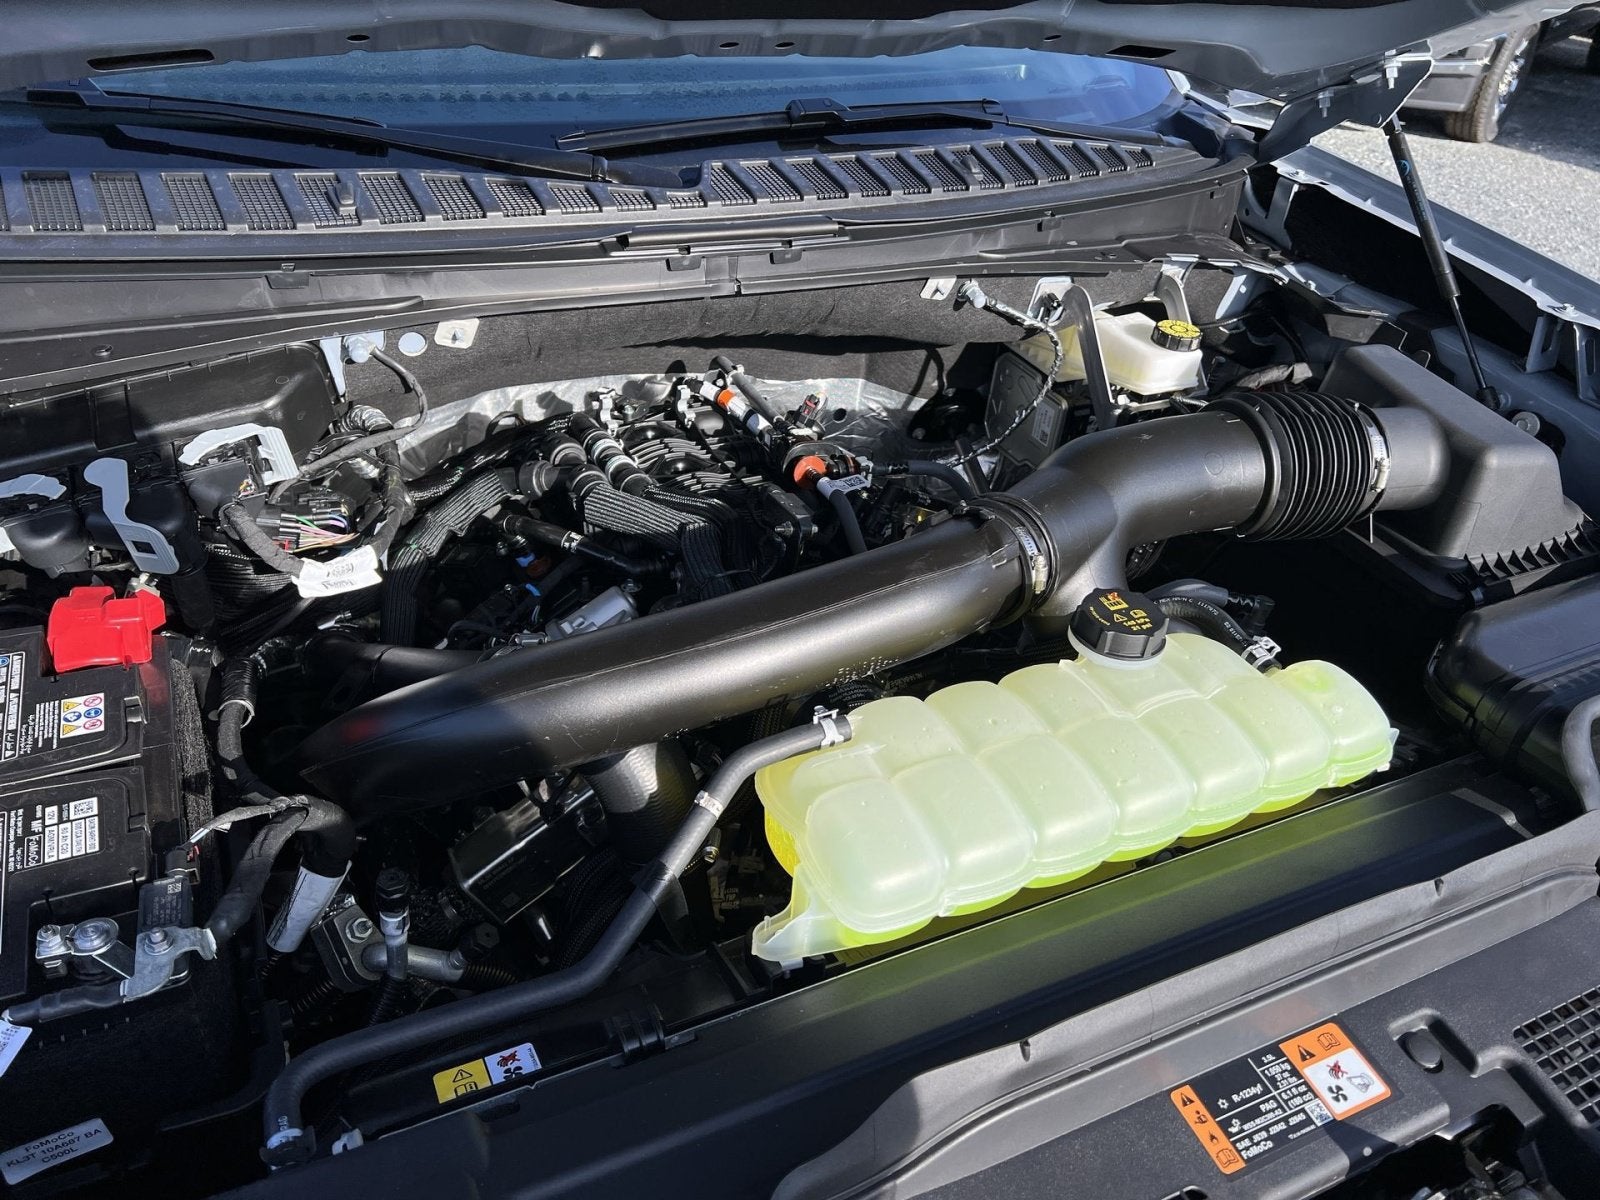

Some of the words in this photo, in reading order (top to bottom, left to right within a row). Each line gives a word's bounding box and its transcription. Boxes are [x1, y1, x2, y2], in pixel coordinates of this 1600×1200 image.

[47, 810, 55, 820] 12V
[30, 819, 42, 833] MF
[28, 837, 39, 866] FoMoCo
[1279, 1062, 1291, 1071] kg
[1231, 1083, 1263, 1103] R-1234yf
[1280, 1089, 1292, 1100] 6.1
[1297, 1084, 1308, 1093] oz
[1259, 1099, 1278, 1112] PAG
[6, 1152, 37, 1168] KL3T
[83, 1128, 102, 1139] BA
[24, 1131, 75, 1152] FoMoCo
[1235, 1138, 1252, 1150] SAE
[41, 1147, 78, 1164] C500L
[1240, 1140, 1274, 1160] FoMoCo
